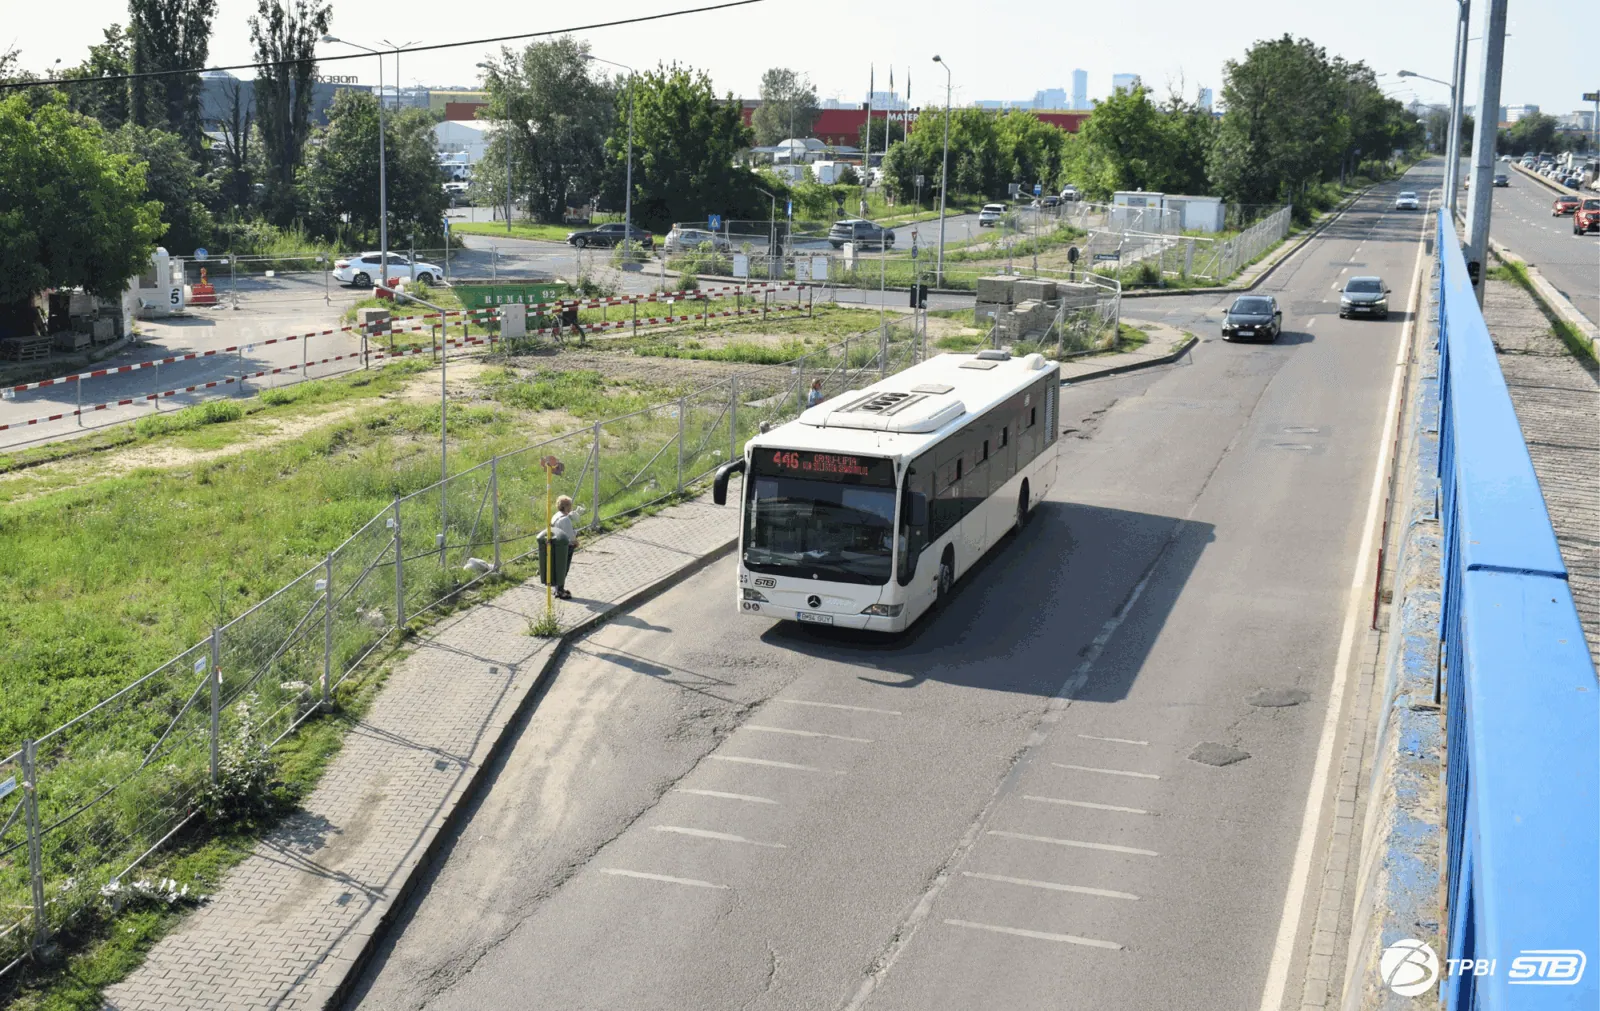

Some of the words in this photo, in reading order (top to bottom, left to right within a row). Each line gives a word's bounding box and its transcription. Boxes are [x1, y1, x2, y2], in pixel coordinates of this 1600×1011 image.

[485, 294, 535, 304] REMAT
[542, 290, 556, 299] 92
[773, 451, 799, 469] 446
[754, 577, 775, 587] STB
